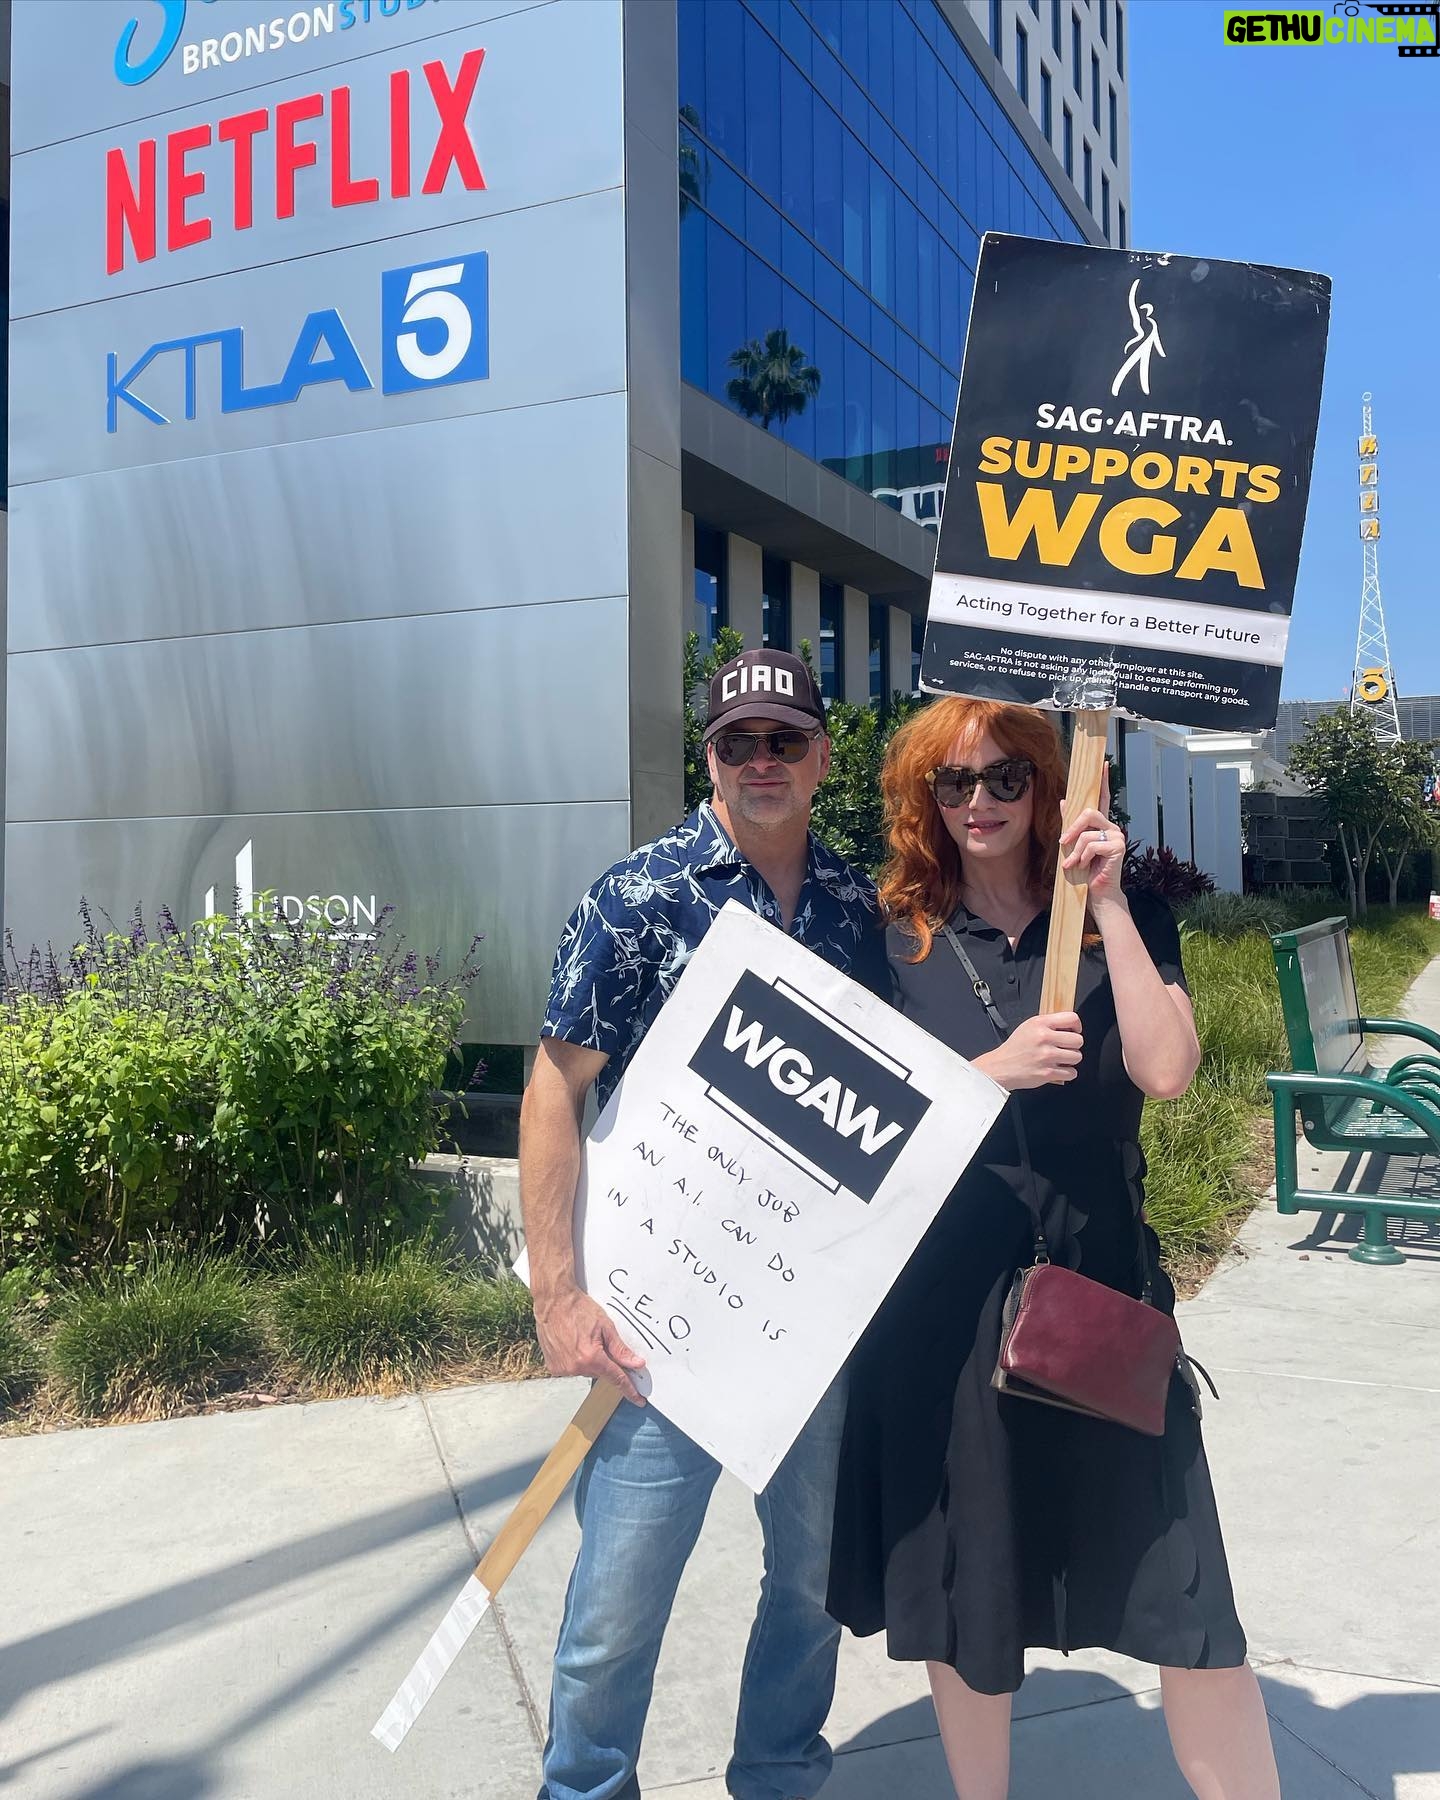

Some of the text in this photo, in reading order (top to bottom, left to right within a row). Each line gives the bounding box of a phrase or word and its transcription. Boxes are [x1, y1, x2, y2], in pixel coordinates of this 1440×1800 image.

[106, 47, 488, 276] NETFLIX
[107, 263, 472, 433] KTLA 5
[978, 436, 1282, 503] SUPPORTS
[976, 481, 1266, 590] WGA
[956, 594, 1261, 645] Acting Together for a Better Future
[1001, 648, 1013, 656] No
[1015, 649, 1048, 661] dispute
[1049, 654, 1069, 663] with
[1071, 657, 1087, 667] any
[1158, 667, 1167, 675] at
[1169, 668, 1186, 677] this
[1187, 671, 1205, 680] site.
[949, 659, 986, 671] services,
[987, 664, 997, 672] or
[998, 665, 1007, 673] to
[1009, 667, 1036, 678] refuse
[1037, 671, 1047, 679] to
[1048, 672, 1067, 682] pick
[1118, 681, 1150, 692] handle
[1162, 687, 1203, 699] transport
[1204, 693, 1220, 702] any
[1222, 695, 1251, 706] goods.
[963, 651, 1014, 665] SAG-AFTRA
[1015, 658, 1023, 666] is
[1024, 660, 1039, 668] not
[1040, 662, 1069, 674] asking
[1071, 666, 1088, 676] any
[1135, 674, 1144, 682] to
[1145, 676, 1171, 685] cease
[1172, 679, 1221, 694] performing
[1223, 686, 1239, 696] any
[1358, 667, 1388, 702] 5
[722, 1004, 904, 1156] WGAW
[660, 1101, 800, 1223] THE ONLY JOB
[633, 1141, 795, 1282] AN A.I. CAN DO
[607, 1187, 788, 1341] IN A STUDIO IS
[608, 1268, 692, 1352] C.E.O.
